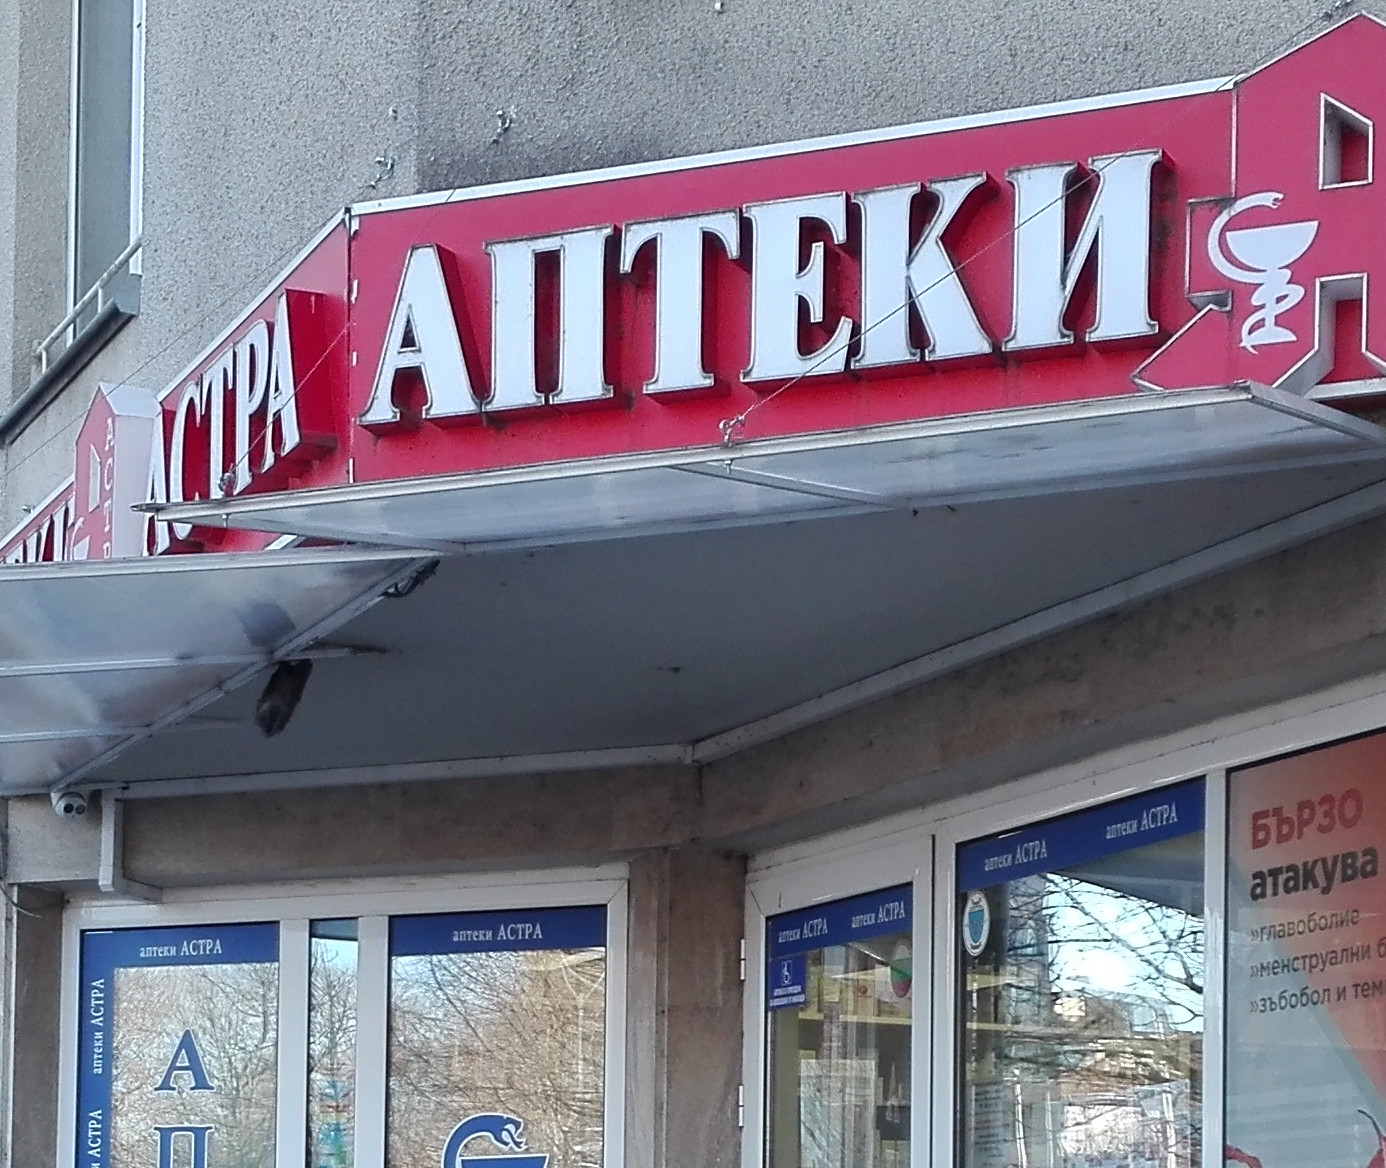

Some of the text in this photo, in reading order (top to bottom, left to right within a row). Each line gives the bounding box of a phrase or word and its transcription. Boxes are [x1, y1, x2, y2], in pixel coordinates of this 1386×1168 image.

[358, 147, 1166, 426] АПТЕКИ
[143, 293, 302, 557] АСТРА
[1140, 802, 1178, 832] АСТРА
[1250, 787, 1364, 851] БЪРЗО
[1014, 839, 1048, 865] АСТРА
[1249, 846, 1379, 901] атакува
[877, 900, 906, 923] АСТРА
[452, 920, 544, 942] аптеки АСТРА
[802, 918, 828, 939] АСТРА
[139, 938, 222, 959] аптеки АСТРА
[1336, 986, 1347, 1002] и
[89, 978, 105, 1075] аптеки АСТРА
[89, 1109, 103, 1159] АСТРА
